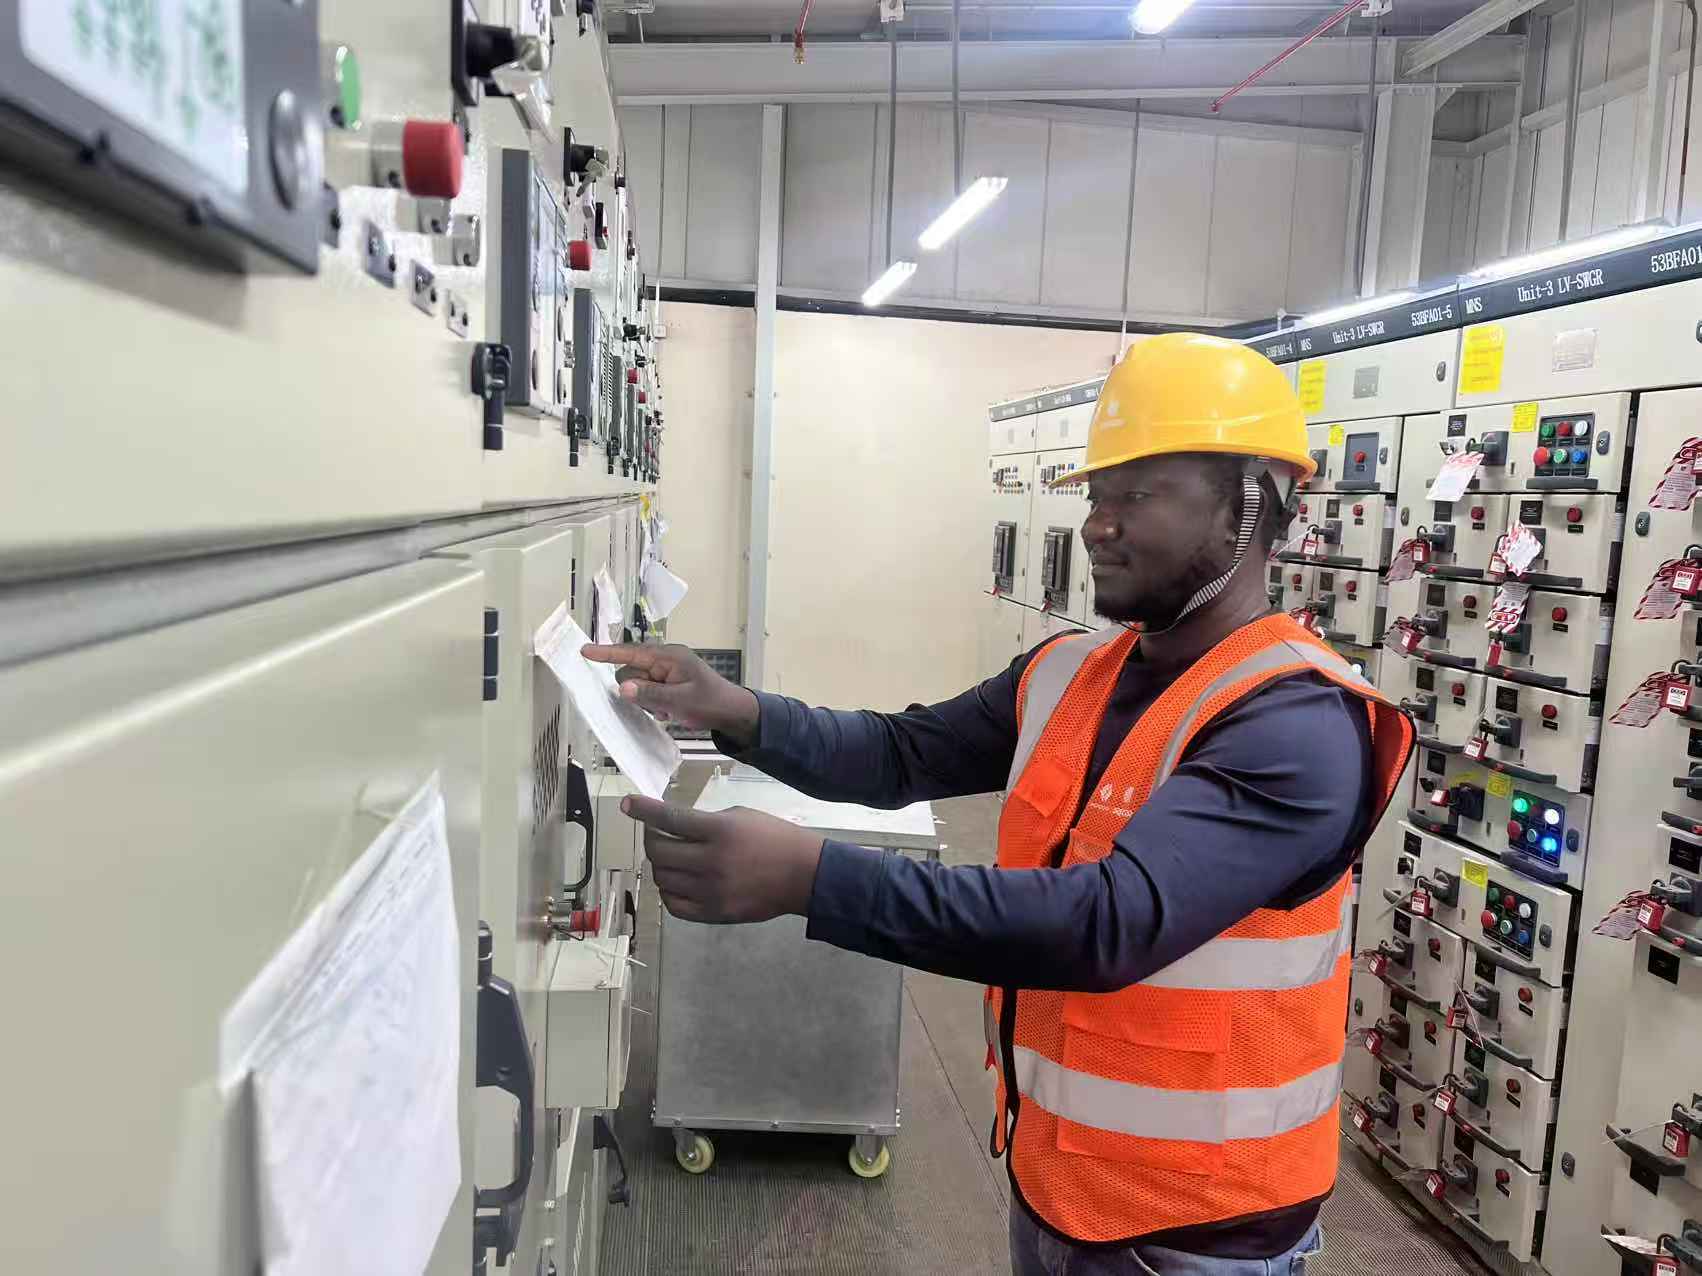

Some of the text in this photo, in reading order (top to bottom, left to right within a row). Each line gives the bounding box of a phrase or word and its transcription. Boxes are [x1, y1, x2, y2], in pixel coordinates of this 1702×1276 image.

[1517, 280, 1554, 303] Unit-3
[1558, 268, 1605, 294] LV-SWGR
[1651, 244, 1702, 273] 53BFA01
[1331, 327, 1355, 345] Unit-3
[1356, 320, 1386, 339] LV-SWGR
[1411, 304, 1453, 327] 53BFA01-5
